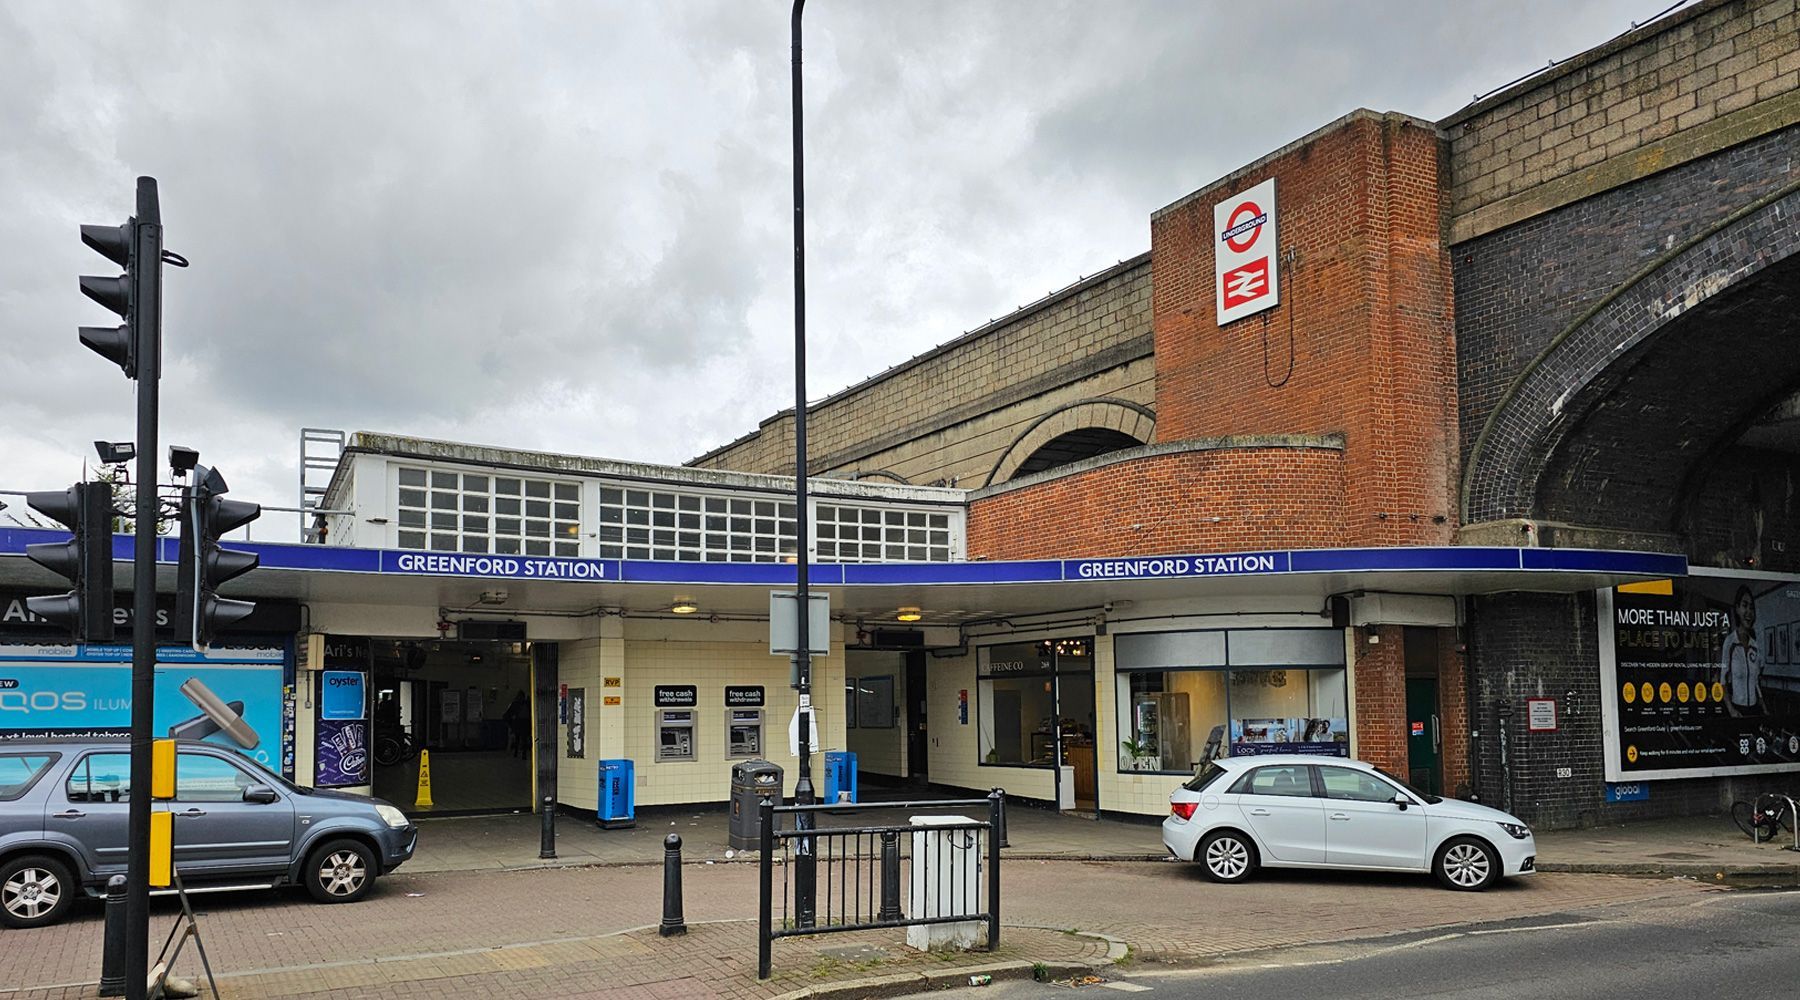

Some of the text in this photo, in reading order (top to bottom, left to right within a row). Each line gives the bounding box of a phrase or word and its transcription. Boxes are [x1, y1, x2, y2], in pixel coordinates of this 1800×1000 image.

[1222, 215, 1267, 240] UNDERGROUND
[398, 555, 604, 578] GREENFORD STATION
[1079, 555, 1273, 577] GREENFORD STATION
[1618, 608, 1731, 627] MORE THAN JUST A
[1619, 630, 1710, 649] PLACE TO LIVE
[325, 644, 353, 657] Ari's
[329, 677, 359, 688] oyster
[676, 689, 693, 697] cash
[0, 692, 87, 714] QOS
[1615, 783, 1640, 800] global
